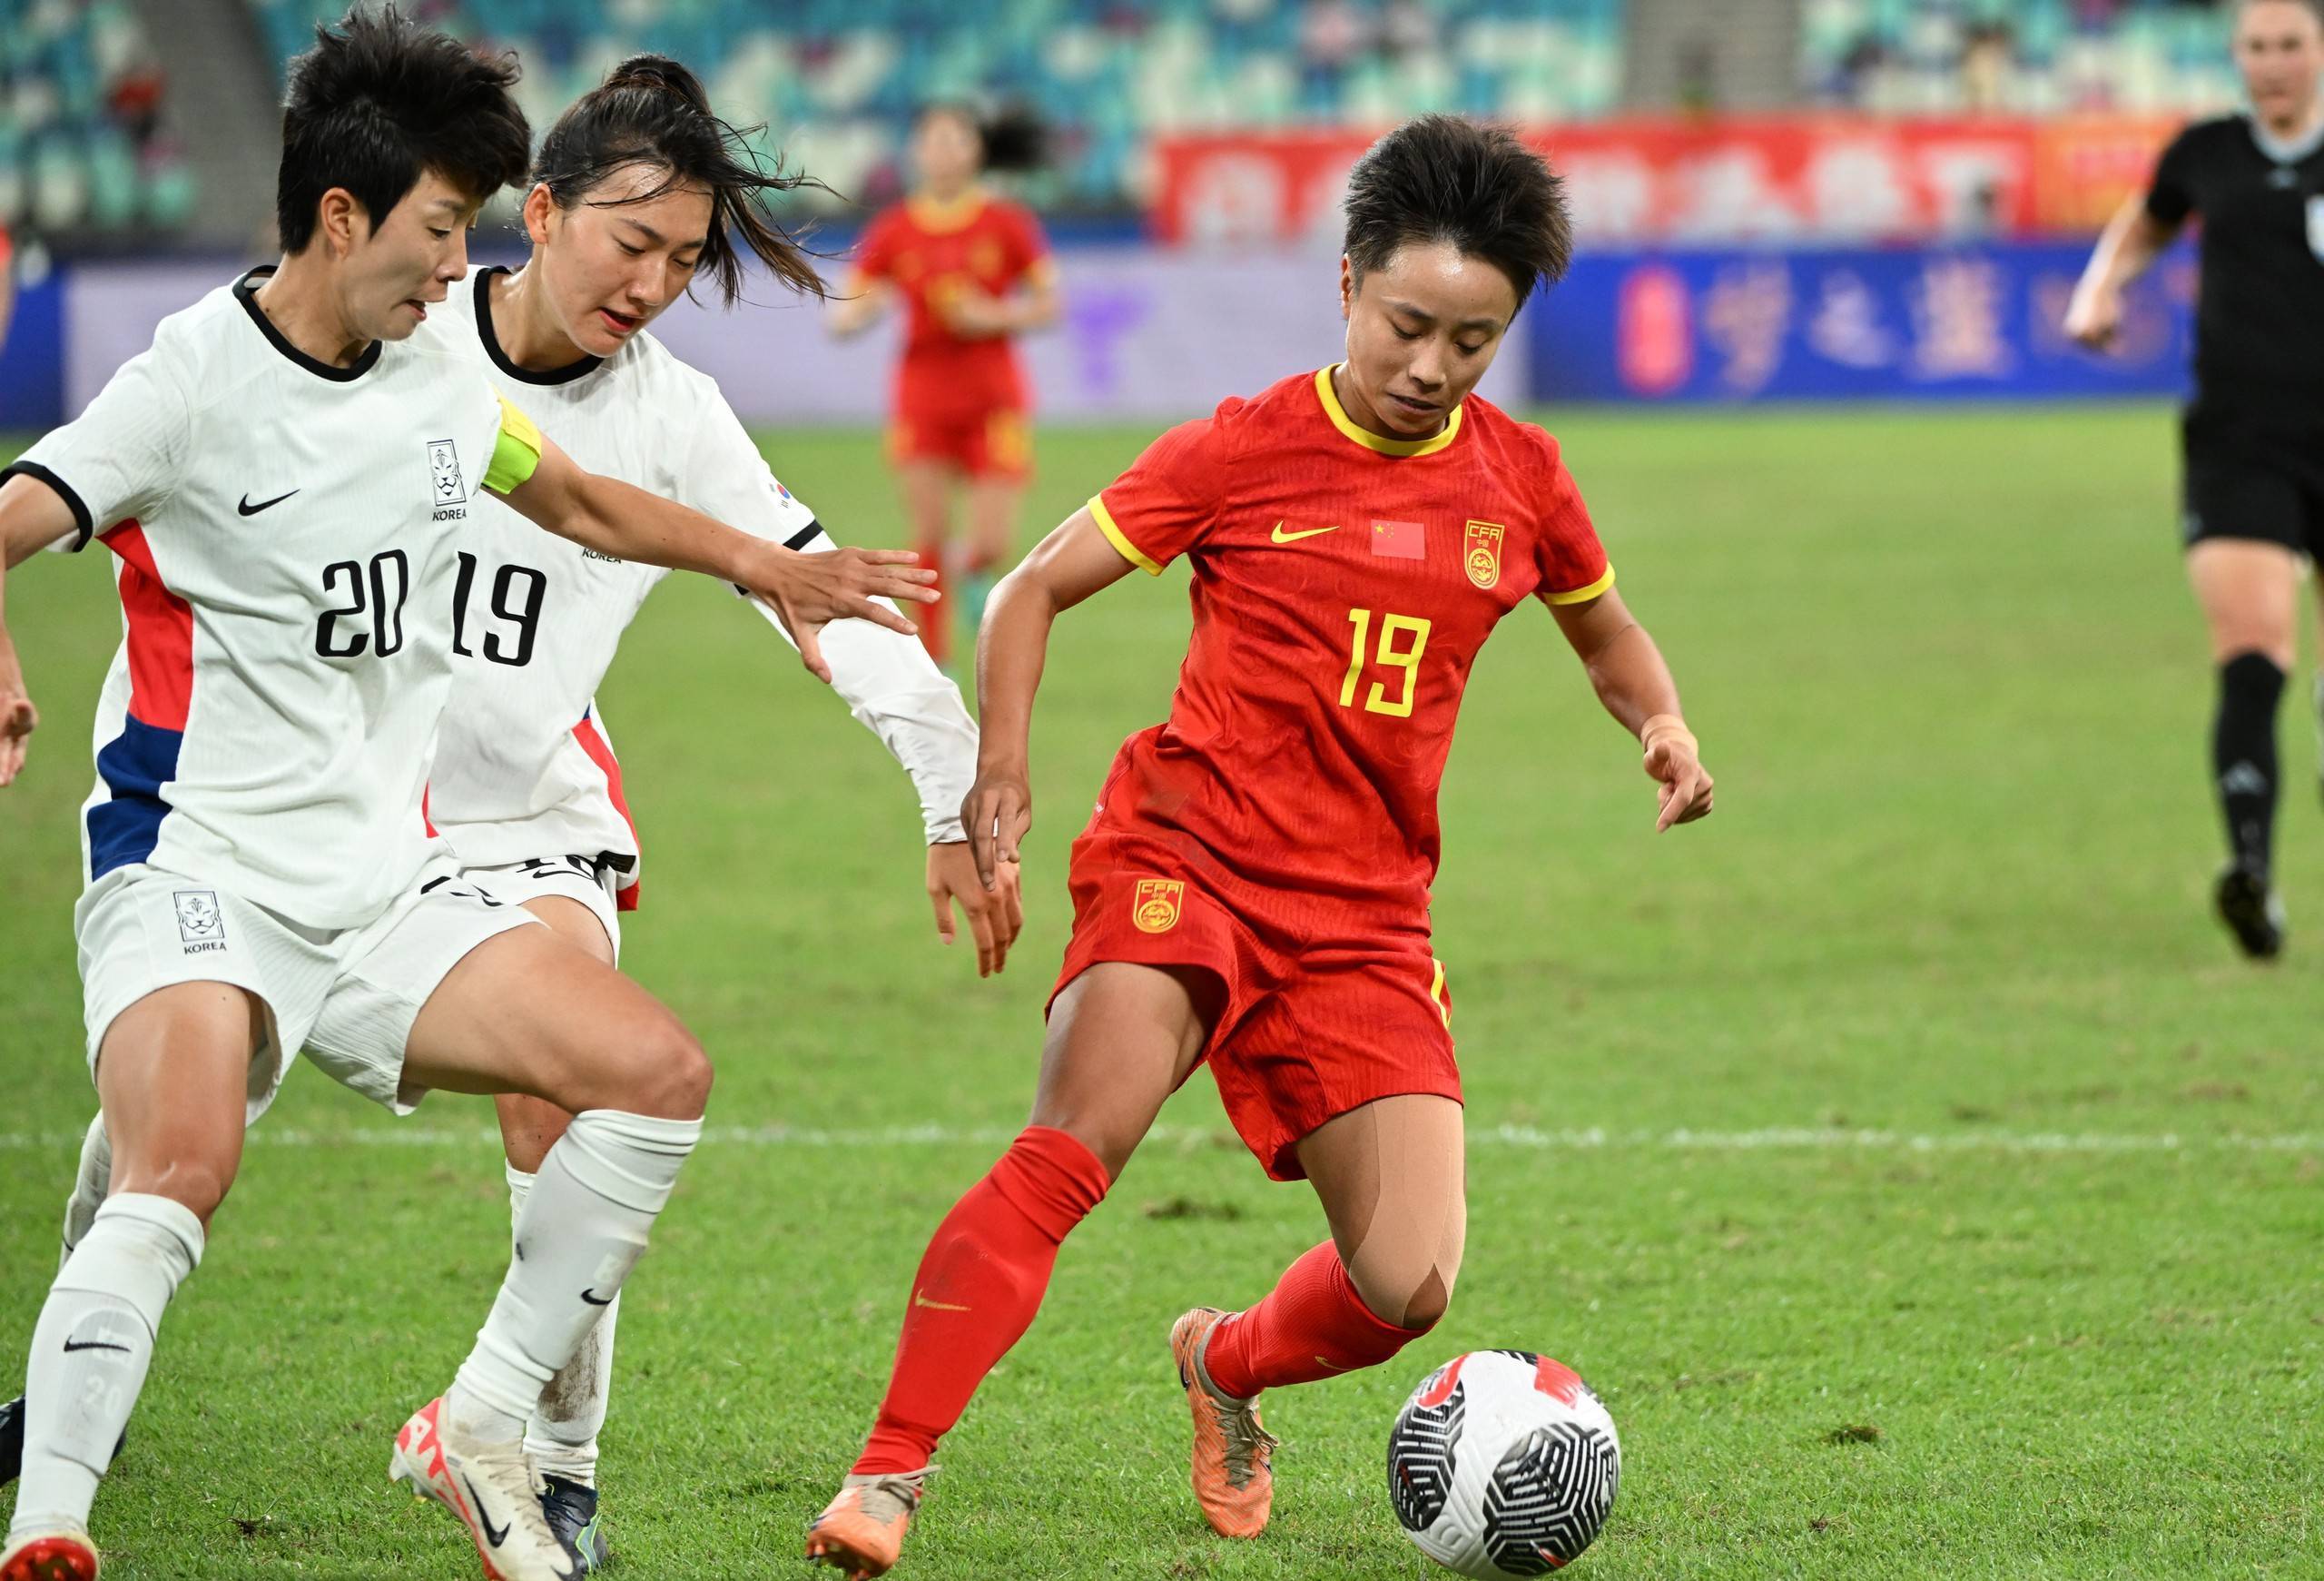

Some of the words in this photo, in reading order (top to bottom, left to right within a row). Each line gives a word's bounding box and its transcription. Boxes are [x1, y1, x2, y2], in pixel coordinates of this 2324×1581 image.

[432, 508, 468, 521] KOREA
[1469, 525, 1500, 540] CFA
[316, 548, 409, 658] 20
[453, 550, 547, 667] 19
[1339, 608, 1432, 718] 19
[1141, 884, 1179, 894] CFA
[183, 942, 227, 954] KOREA
